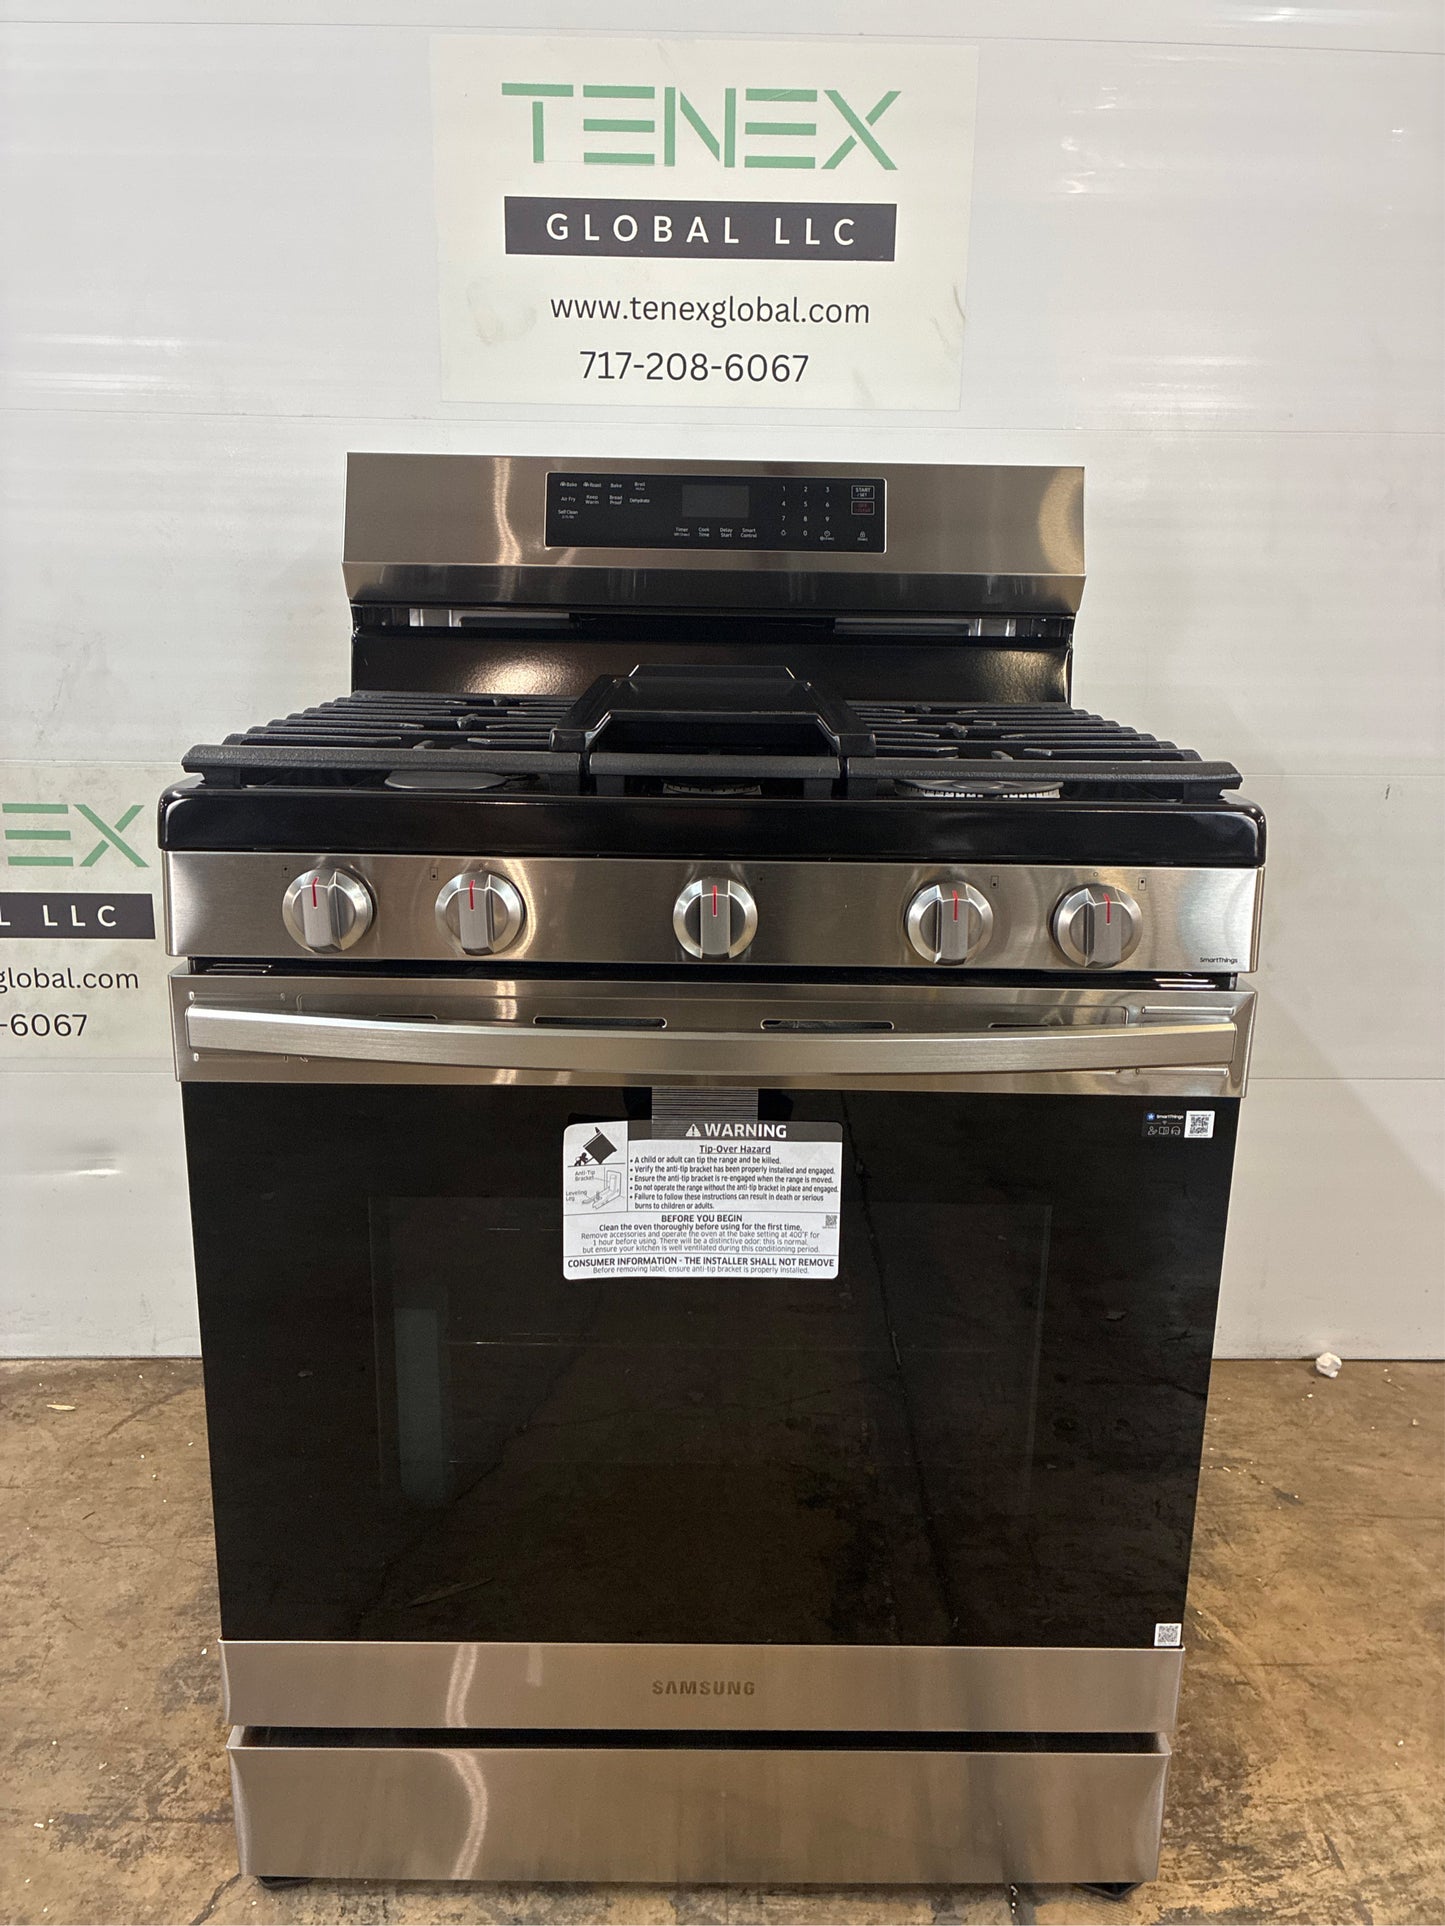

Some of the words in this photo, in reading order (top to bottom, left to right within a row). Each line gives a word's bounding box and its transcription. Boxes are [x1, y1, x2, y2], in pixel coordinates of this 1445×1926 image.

[502, 83, 901, 170] TENEX
[546, 214, 739, 244] GLOBAL
[774, 217, 856, 246] LLC
[550, 296, 870, 328] www.tenexglobal.com
[580, 350, 809, 382] 717-208-6067
[43, 905, 117, 927] LLC
[1200, 957, 1238, 965] SmartThings
[704, 1123, 787, 1139] WARNING
[699, 1145, 738, 1154] Tip-Over
[740, 1145, 771, 1153] Hazard
[634, 1165, 654, 1174] Verify
[666, 1165, 689, 1173] anti-tip
[741, 1166, 768, 1174] properly
[769, 1166, 794, 1174] installed
[668, 1175, 690, 1183] anti-tip
[721, 1175, 755, 1183] re-engaged
[736, 1184, 757, 1192] anti-tip
[758, 1184, 779, 1192] bracket
[786, 1185, 801, 1193] place
[813, 1186, 839, 1194] engaged.
[702, 1192, 737, 1200] instructions
[802, 1194, 824, 1202] serious
[635, 1202, 652, 1210] burns
[660, 1202, 685, 1210] children
[694, 1202, 714, 1210] adults.
[661, 1214, 694, 1223] BEFORE
[696, 1214, 715, 1222] YOU
[716, 1214, 743, 1223] BEGIN
[599, 1224, 619, 1232] Clean
[653, 1223, 694, 1233] thoroughly
[720, 1224, 740, 1232] using
[581, 1232, 608, 1240] Remove
[609, 1231, 646, 1239] accessories
[647, 1231, 660, 1239] and
[661, 1231, 687, 1240] operate
[689, 1231, 699, 1239] the
[727, 1231, 738, 1239] the
[739, 1231, 755, 1239] bake
[756, 1232, 780, 1240] setting
[810, 1232, 820, 1240] for
[582, 1246, 594, 1254] but
[636, 1245, 660, 1253] kitchen
[684, 1244, 717, 1252] ventilated
[718, 1244, 740, 1253] during
[755, 1245, 796, 1254] conditioning
[567, 1258, 615, 1269] CONSUMER
[617, 1256, 677, 1266] INFORMATION
[684, 1256, 701, 1265] THE
[703, 1256, 748, 1265] INSTALLER
[750, 1257, 777, 1266] SHALL
[779, 1257, 797, 1265] NOT
[799, 1258, 835, 1268] REMOVE
[593, 1266, 615, 1274] Before
[616, 1265, 648, 1274] removing
[691, 1264, 715, 1273] anti-tip
[750, 1265, 779, 1274] properly
[780, 1266, 809, 1274] installed.
[652, 1680, 756, 1696] SAMSUNG
